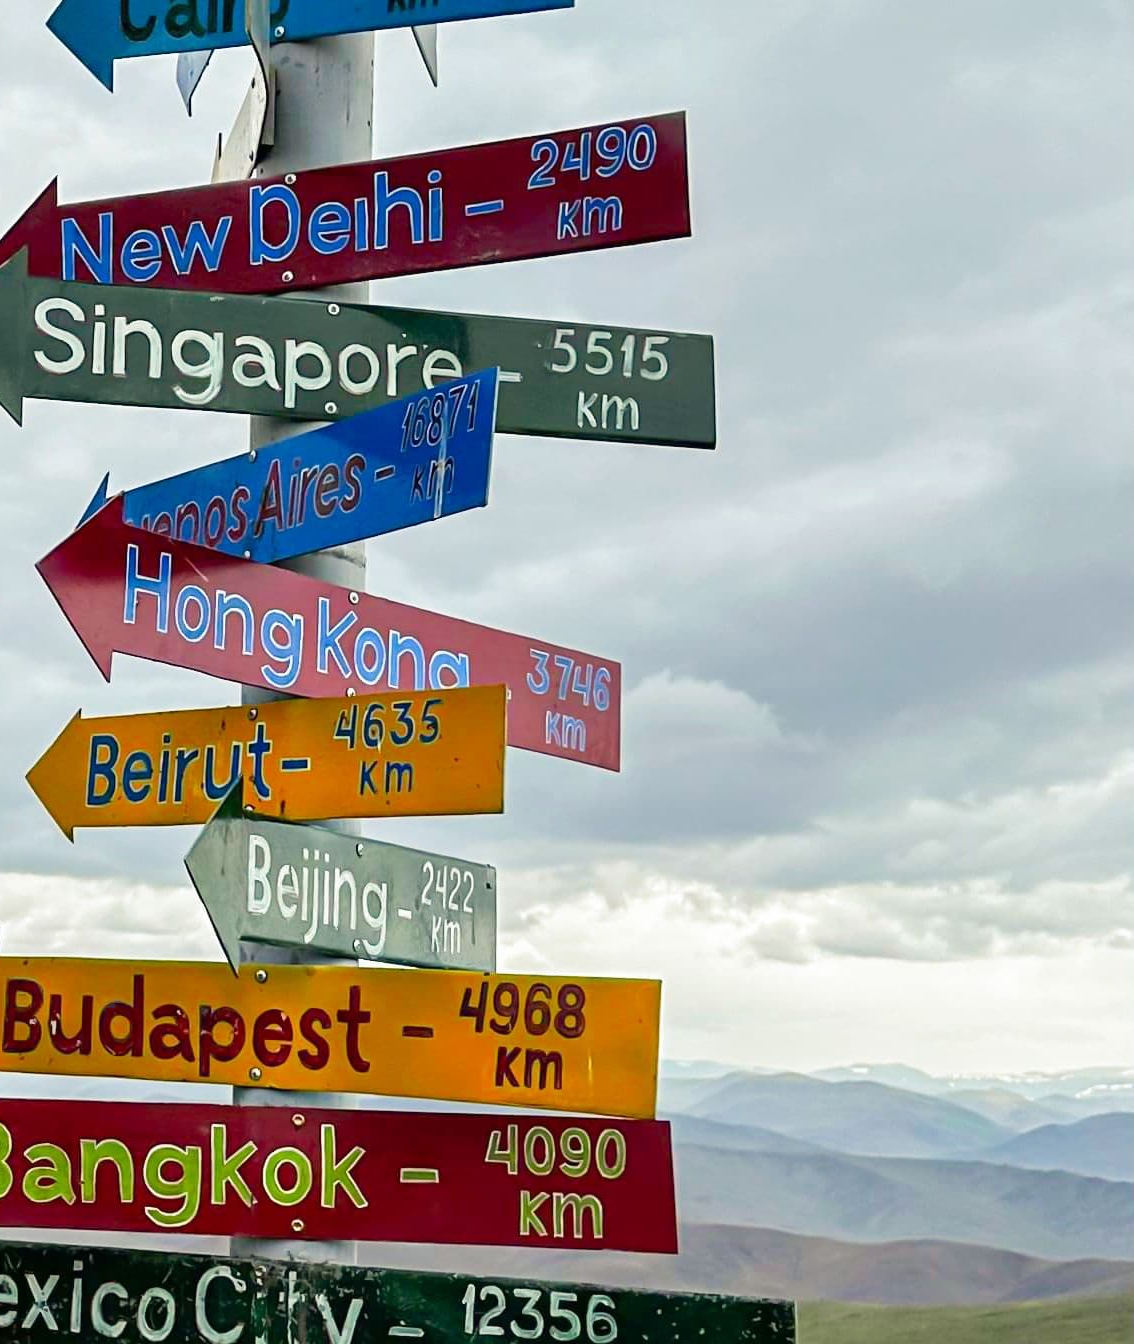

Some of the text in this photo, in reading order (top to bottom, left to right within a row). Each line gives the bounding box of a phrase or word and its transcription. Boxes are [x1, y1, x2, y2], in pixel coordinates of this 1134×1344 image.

[61, 211, 233, 284] New
[251, 170, 445, 266] Delhi
[528, 124, 658, 190] 2490
[33, 297, 466, 408] Singapore
[551, 328, 670, 383] 5515
[253, 453, 366, 538] Aires
[400, 379, 480, 452] 16871
[123, 543, 613, 712] Hong Kong 3746
[335, 698, 443, 751] 4635
[246, 834, 389, 955] Beijing
[420, 861, 475, 914] 2422
[1, 974, 373, 1073] Budapest
[459, 973, 587, 1037] 4968
[483, 1123, 628, 1180] 4090
